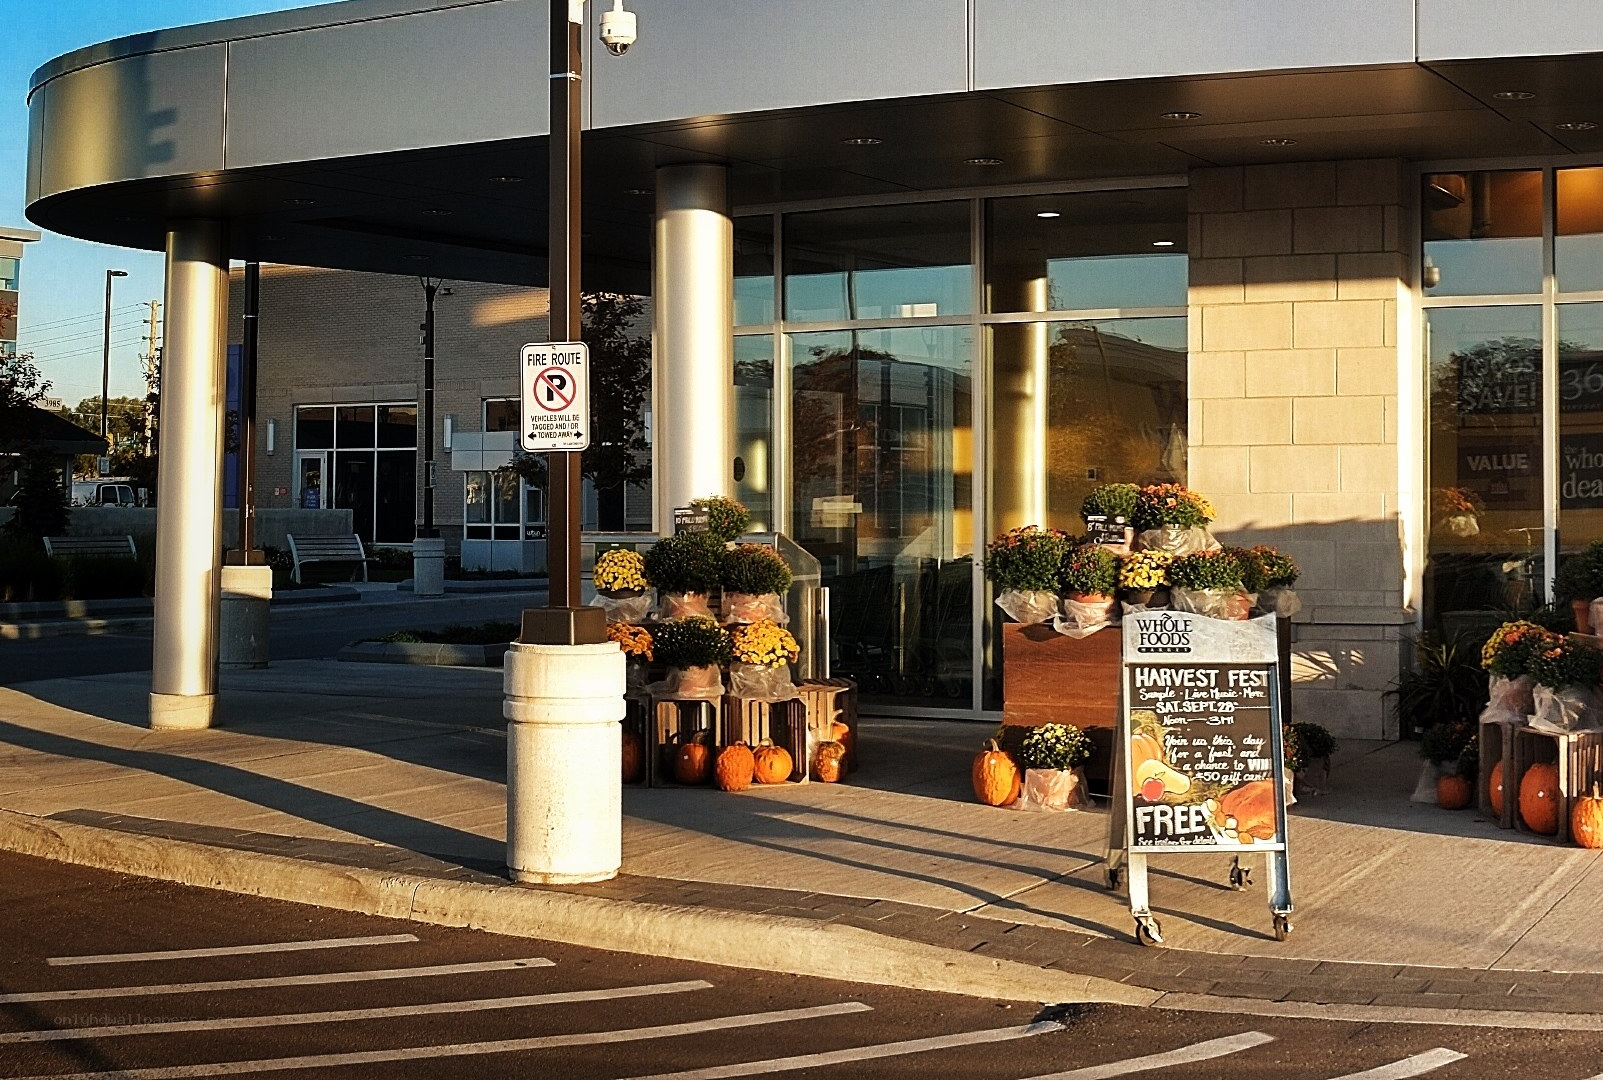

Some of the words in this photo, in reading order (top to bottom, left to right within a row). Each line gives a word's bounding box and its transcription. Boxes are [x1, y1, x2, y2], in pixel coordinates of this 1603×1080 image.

[527, 353, 547, 366] FIRE
[552, 352, 581, 366] ROUTE
[558, 414, 572, 422] WILL
[532, 423, 554, 431] TAGGED
[538, 431, 557, 439] TOWED
[1466, 454, 1528, 470] VALUE
[1137, 613, 1193, 632] WHOLE
[1140, 633, 1190, 646] FOODS
[1135, 667, 1220, 688] HARVEST
[1228, 669, 1271, 687] FEST
[1185, 689, 1209, 700] Live
[1210, 687, 1239, 700] Music
[1242, 734, 1267, 752] day
[1170, 747, 1190, 763] for
[1240, 748, 1260, 758] and
[1183, 763, 1192, 771] a
[1194, 760, 1230, 770] chance
[1233, 760, 1246, 771] to
[1221, 771, 1242, 786] gift
[1135, 804, 1206, 836] FREE
